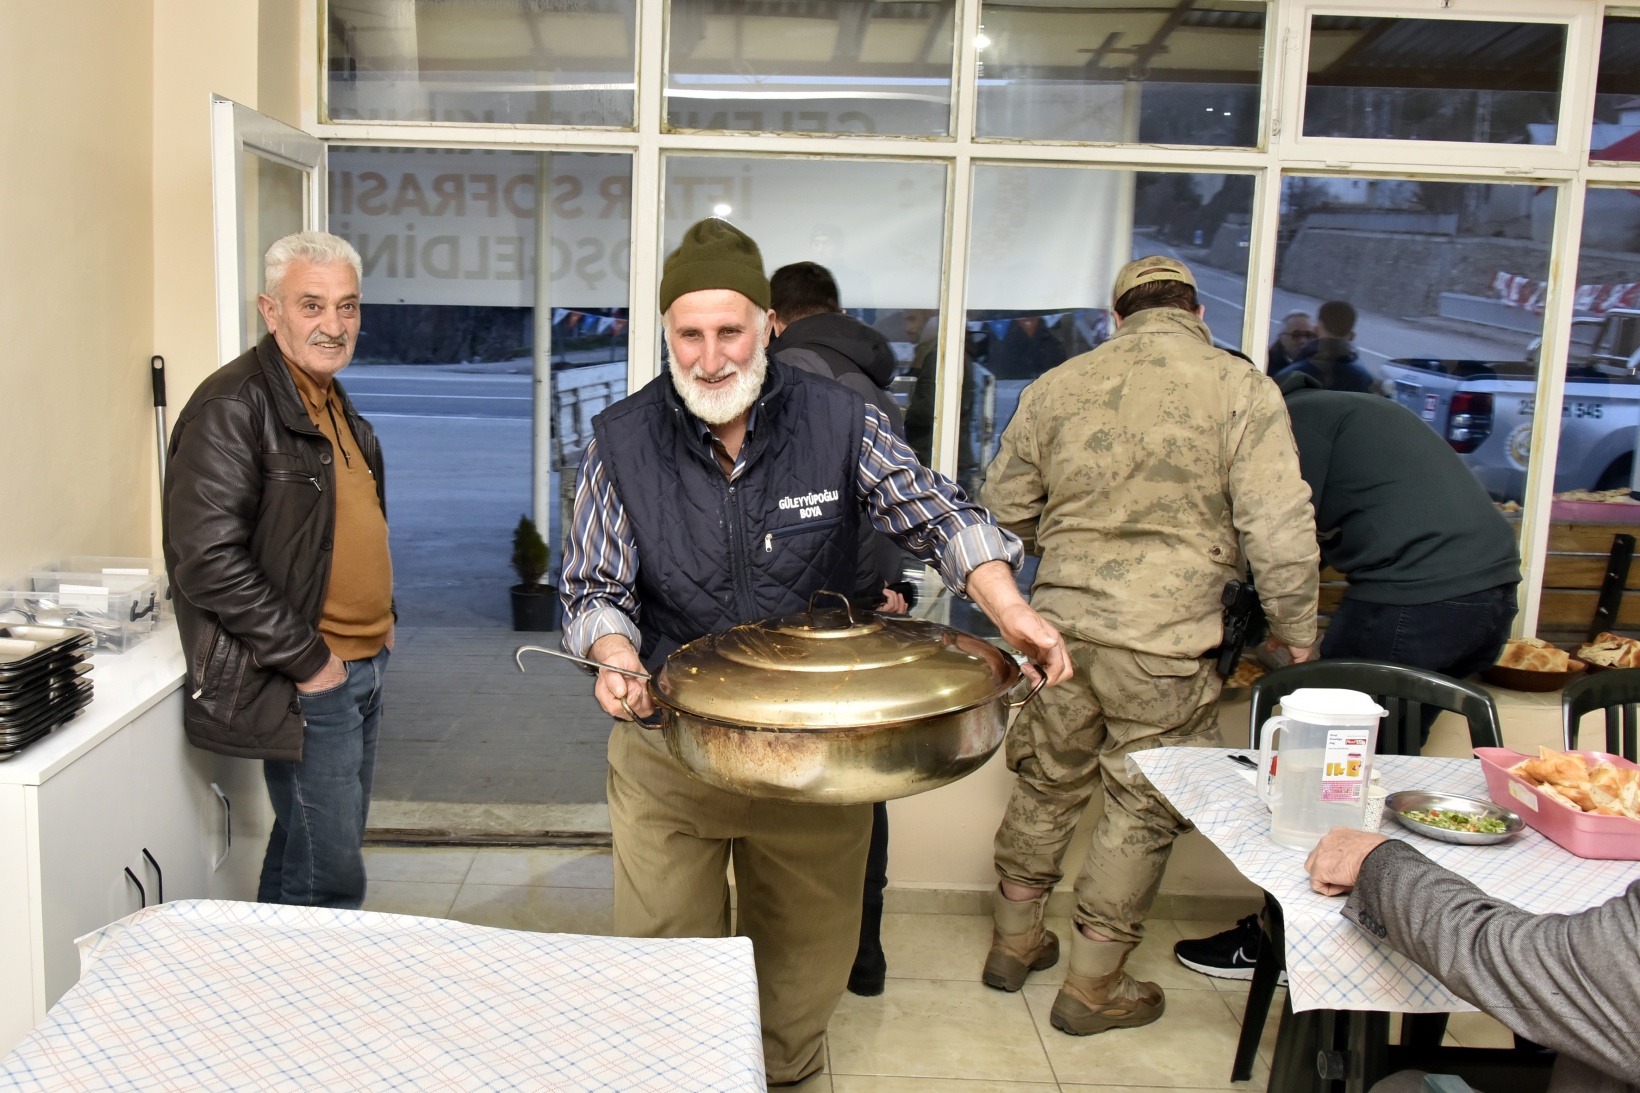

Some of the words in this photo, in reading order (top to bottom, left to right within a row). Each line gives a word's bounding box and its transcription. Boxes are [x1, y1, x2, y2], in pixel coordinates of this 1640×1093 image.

[1575, 402, 1604, 419] 545
[779, 489, 839, 509] GÜLEYYÜPOĞLU
[800, 506, 822, 519] BOYA
